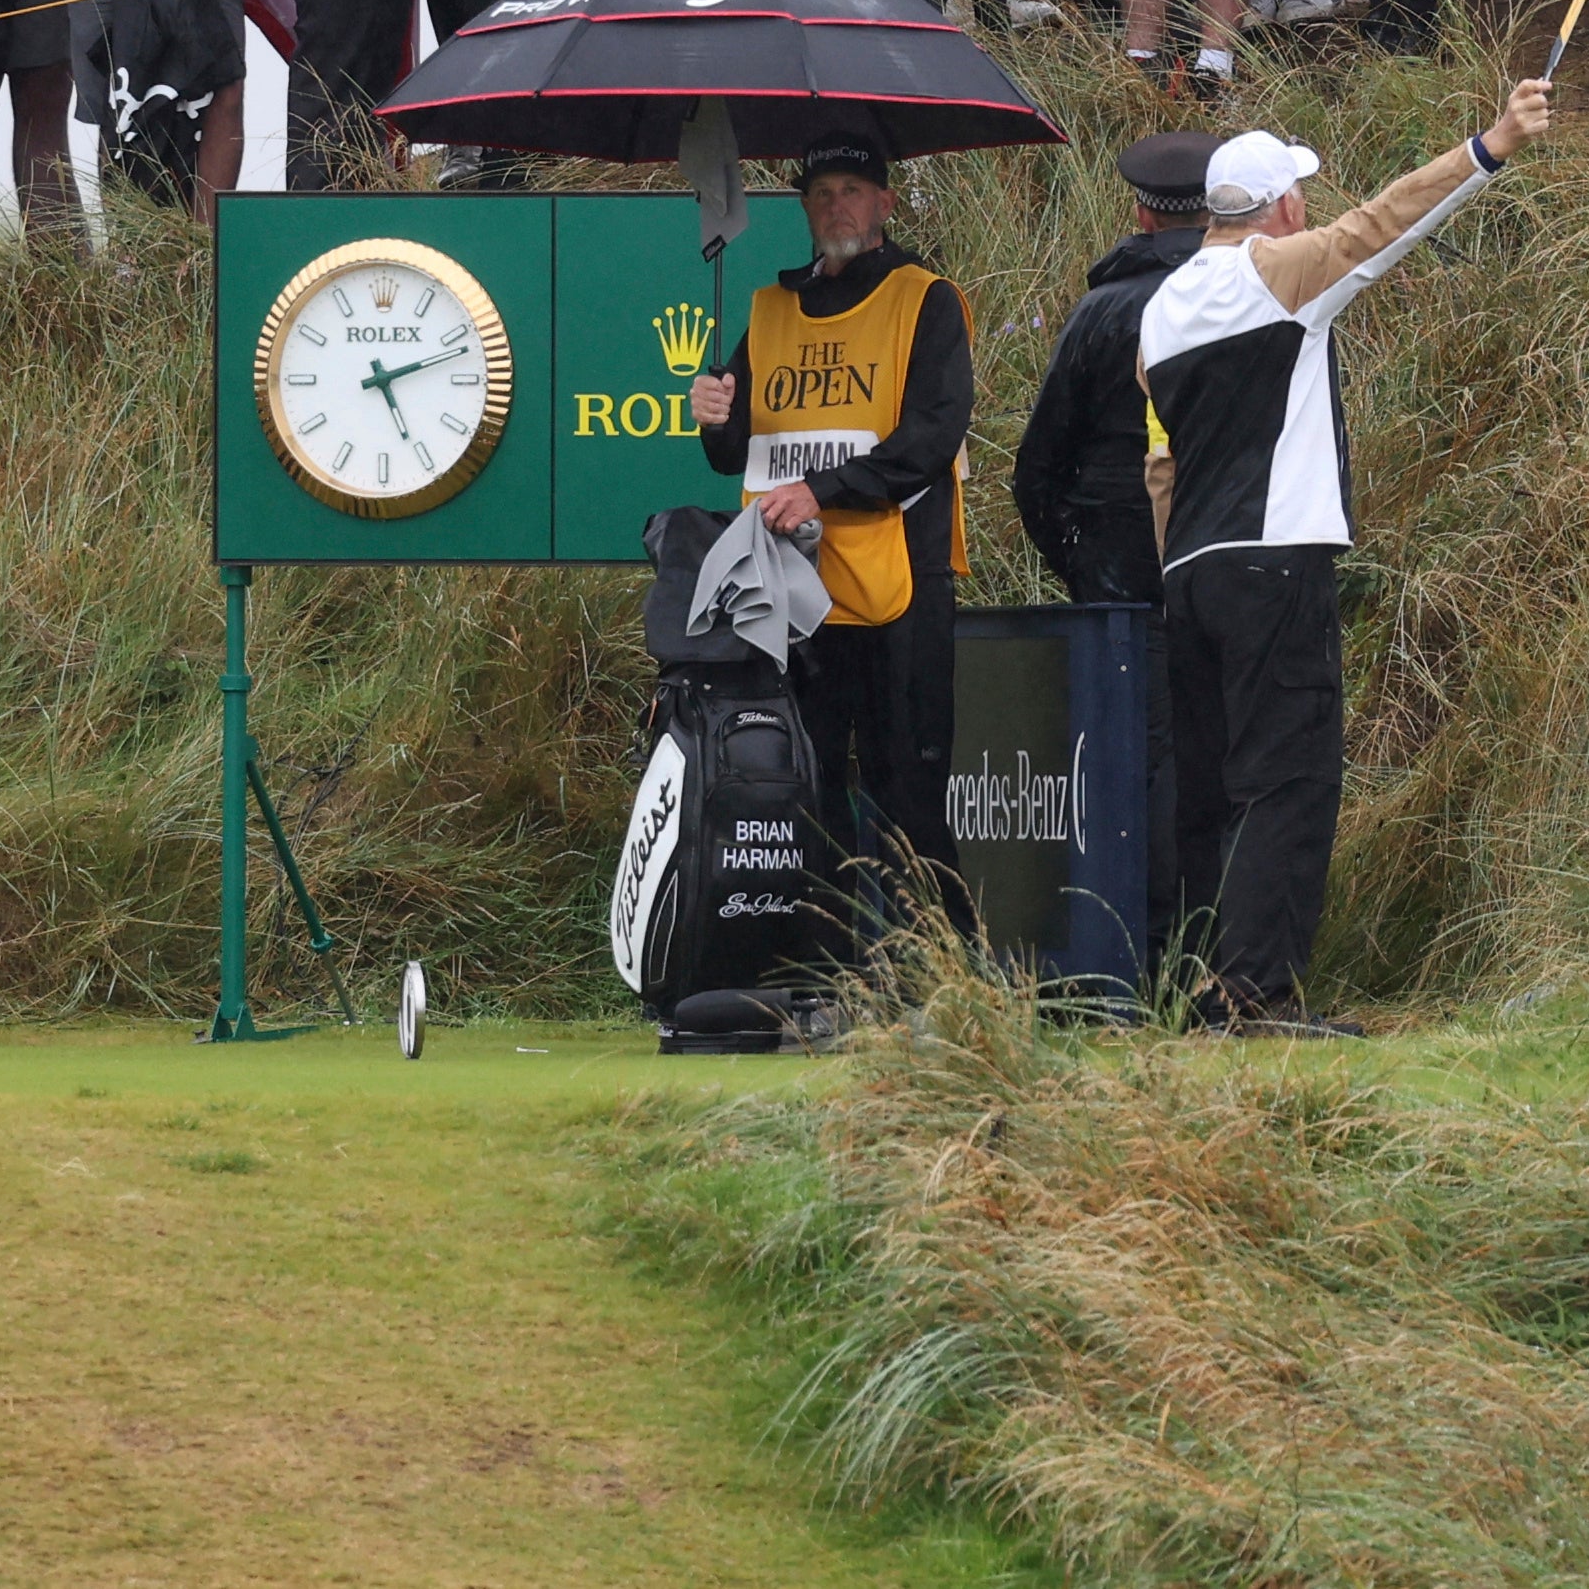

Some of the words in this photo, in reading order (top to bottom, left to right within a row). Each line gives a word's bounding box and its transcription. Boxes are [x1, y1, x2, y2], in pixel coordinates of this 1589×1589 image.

[346, 326, 423, 343] ROLEX
[798, 341, 846, 367] THE
[764, 362, 879, 412] OPEN
[573, 392, 701, 438] ROL
[946, 749, 1068, 841] rcedes-Benz
[735, 820, 794, 842] BRIAN
[617, 777, 677, 970] Titleist
[722, 847, 804, 870] HARMAN
